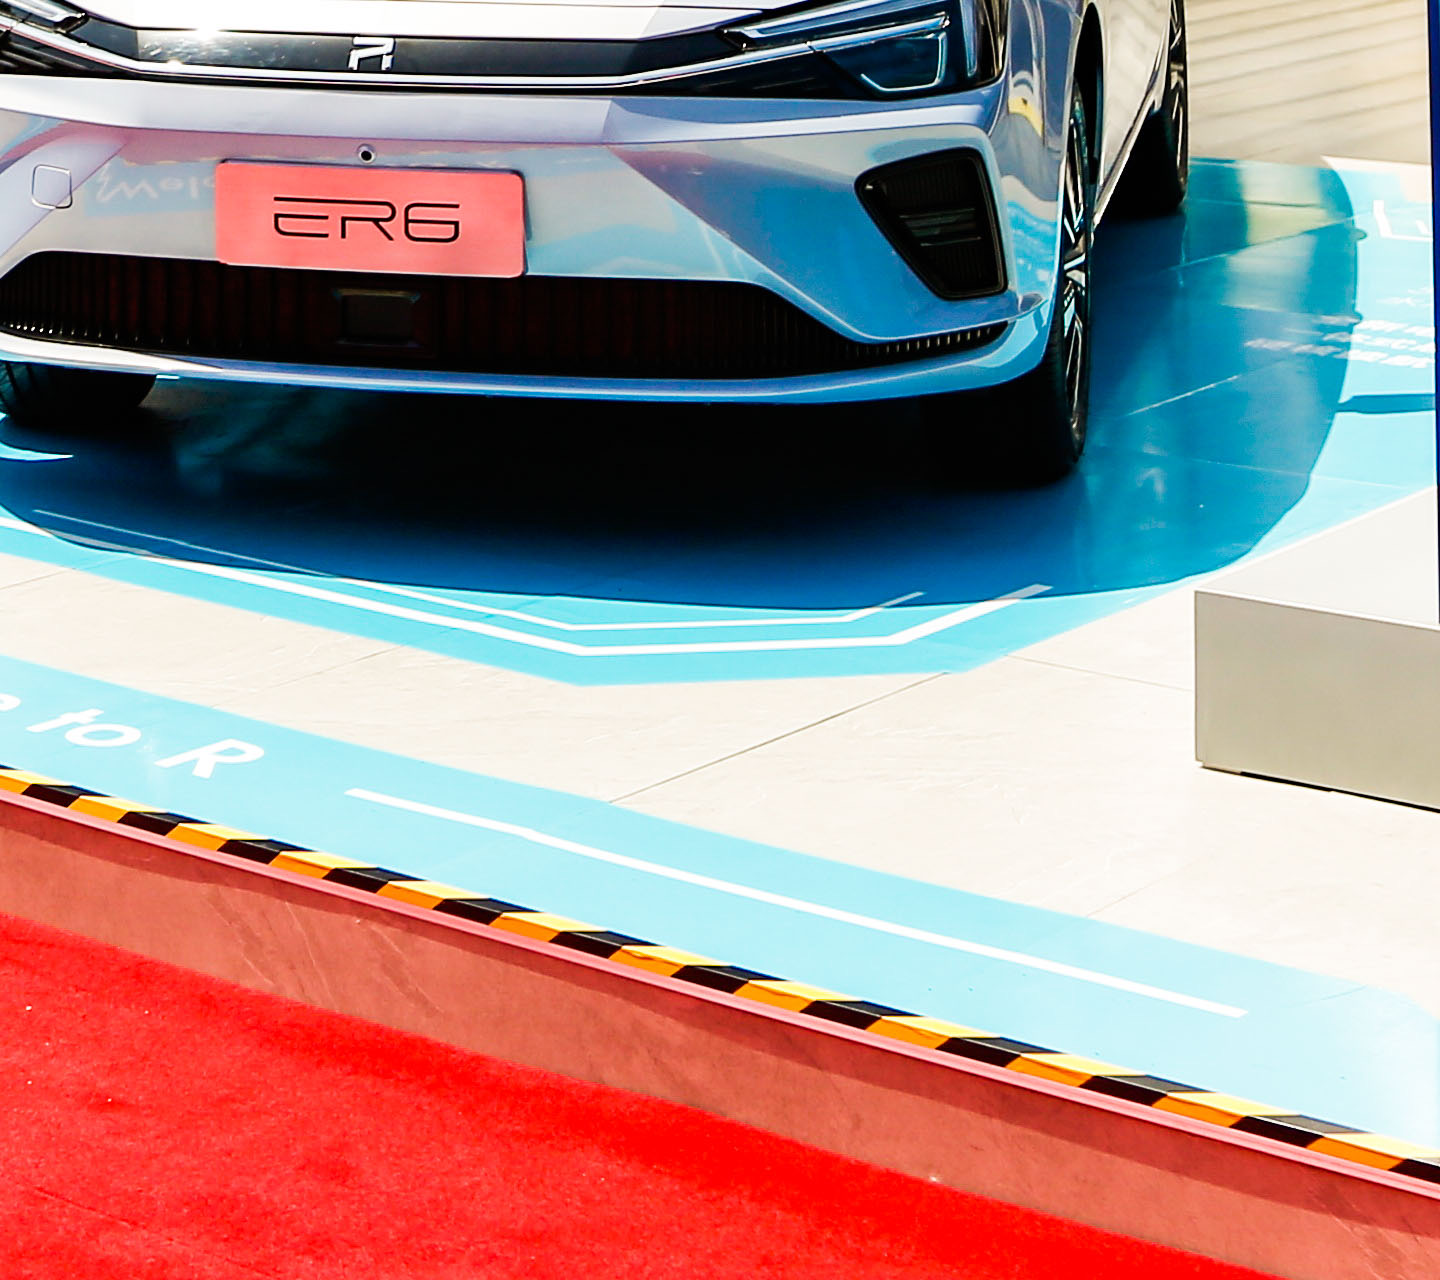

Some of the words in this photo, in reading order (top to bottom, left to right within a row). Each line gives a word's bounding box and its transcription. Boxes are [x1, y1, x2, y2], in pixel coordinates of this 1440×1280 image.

[273, 196, 461, 243] ER6
[25, 707, 142, 748] to
[154, 737, 265, 779] R
